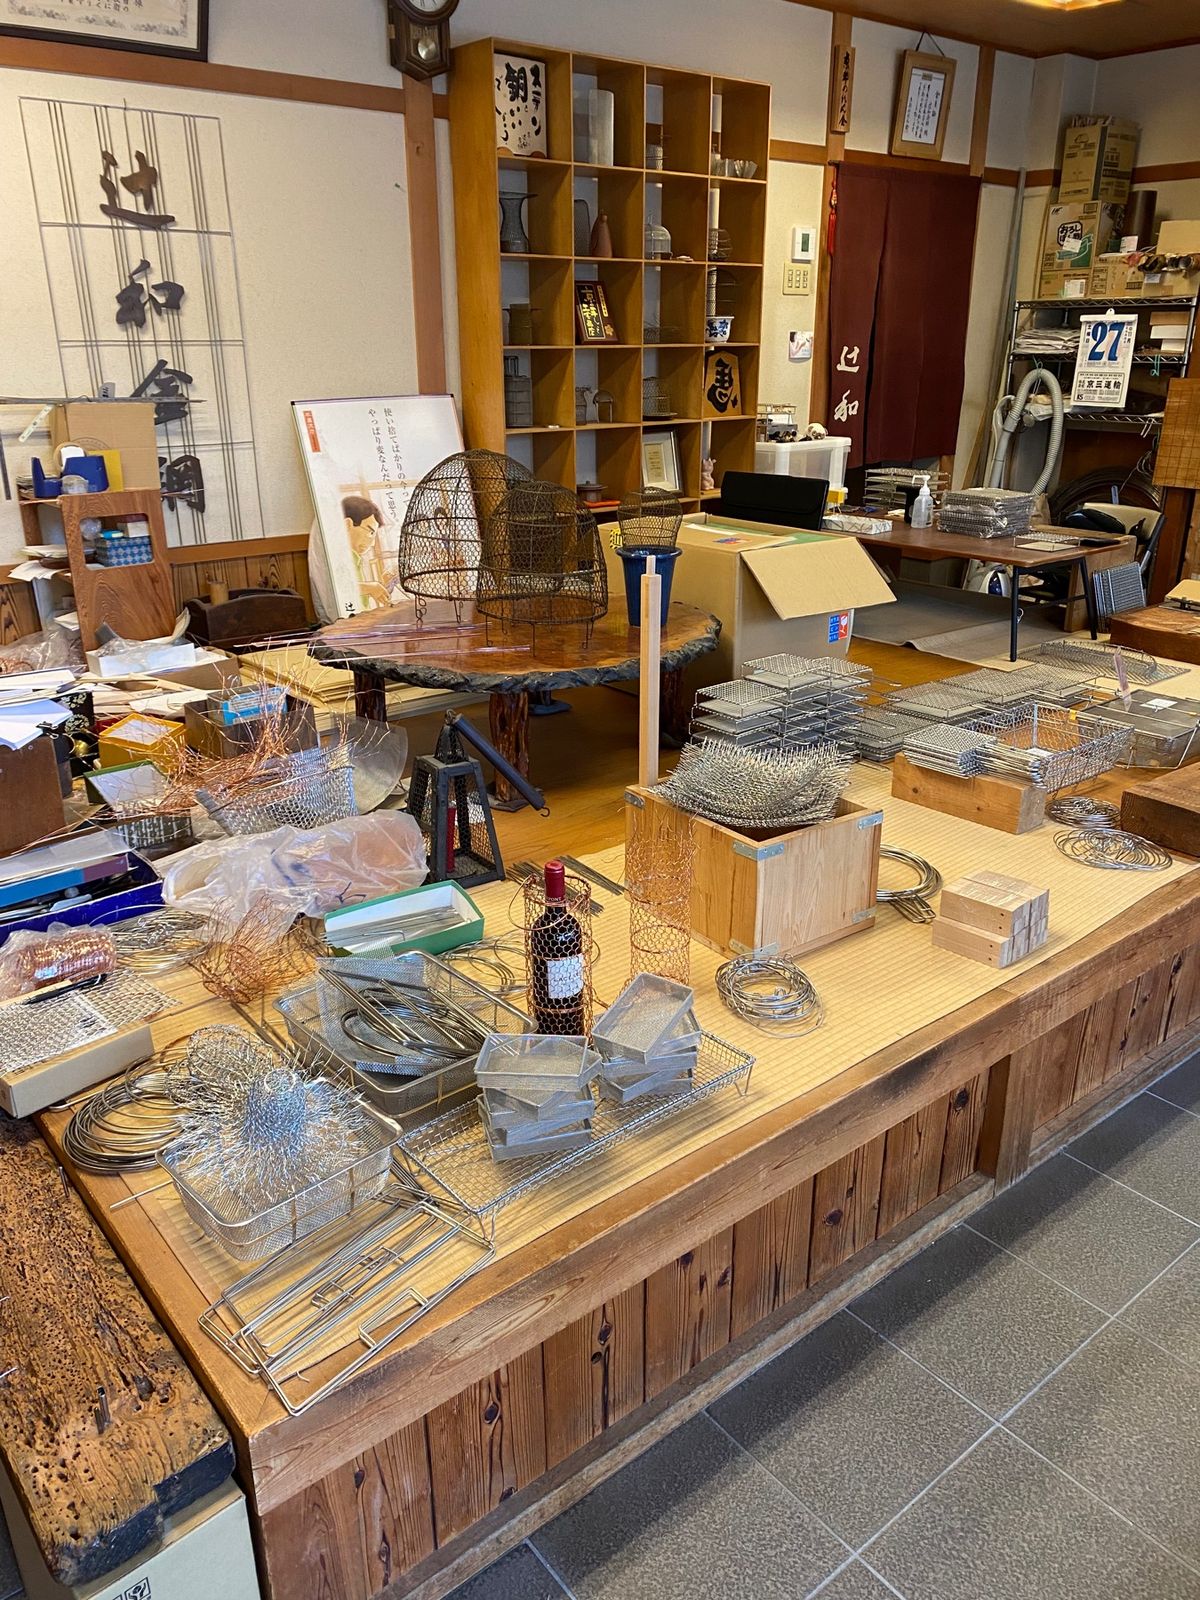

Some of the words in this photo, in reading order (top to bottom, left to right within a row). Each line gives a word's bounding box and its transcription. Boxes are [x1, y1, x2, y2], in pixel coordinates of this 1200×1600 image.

[1087, 322, 1126, 361] 27
[1086, 380, 1122, 390] 京三運輸
